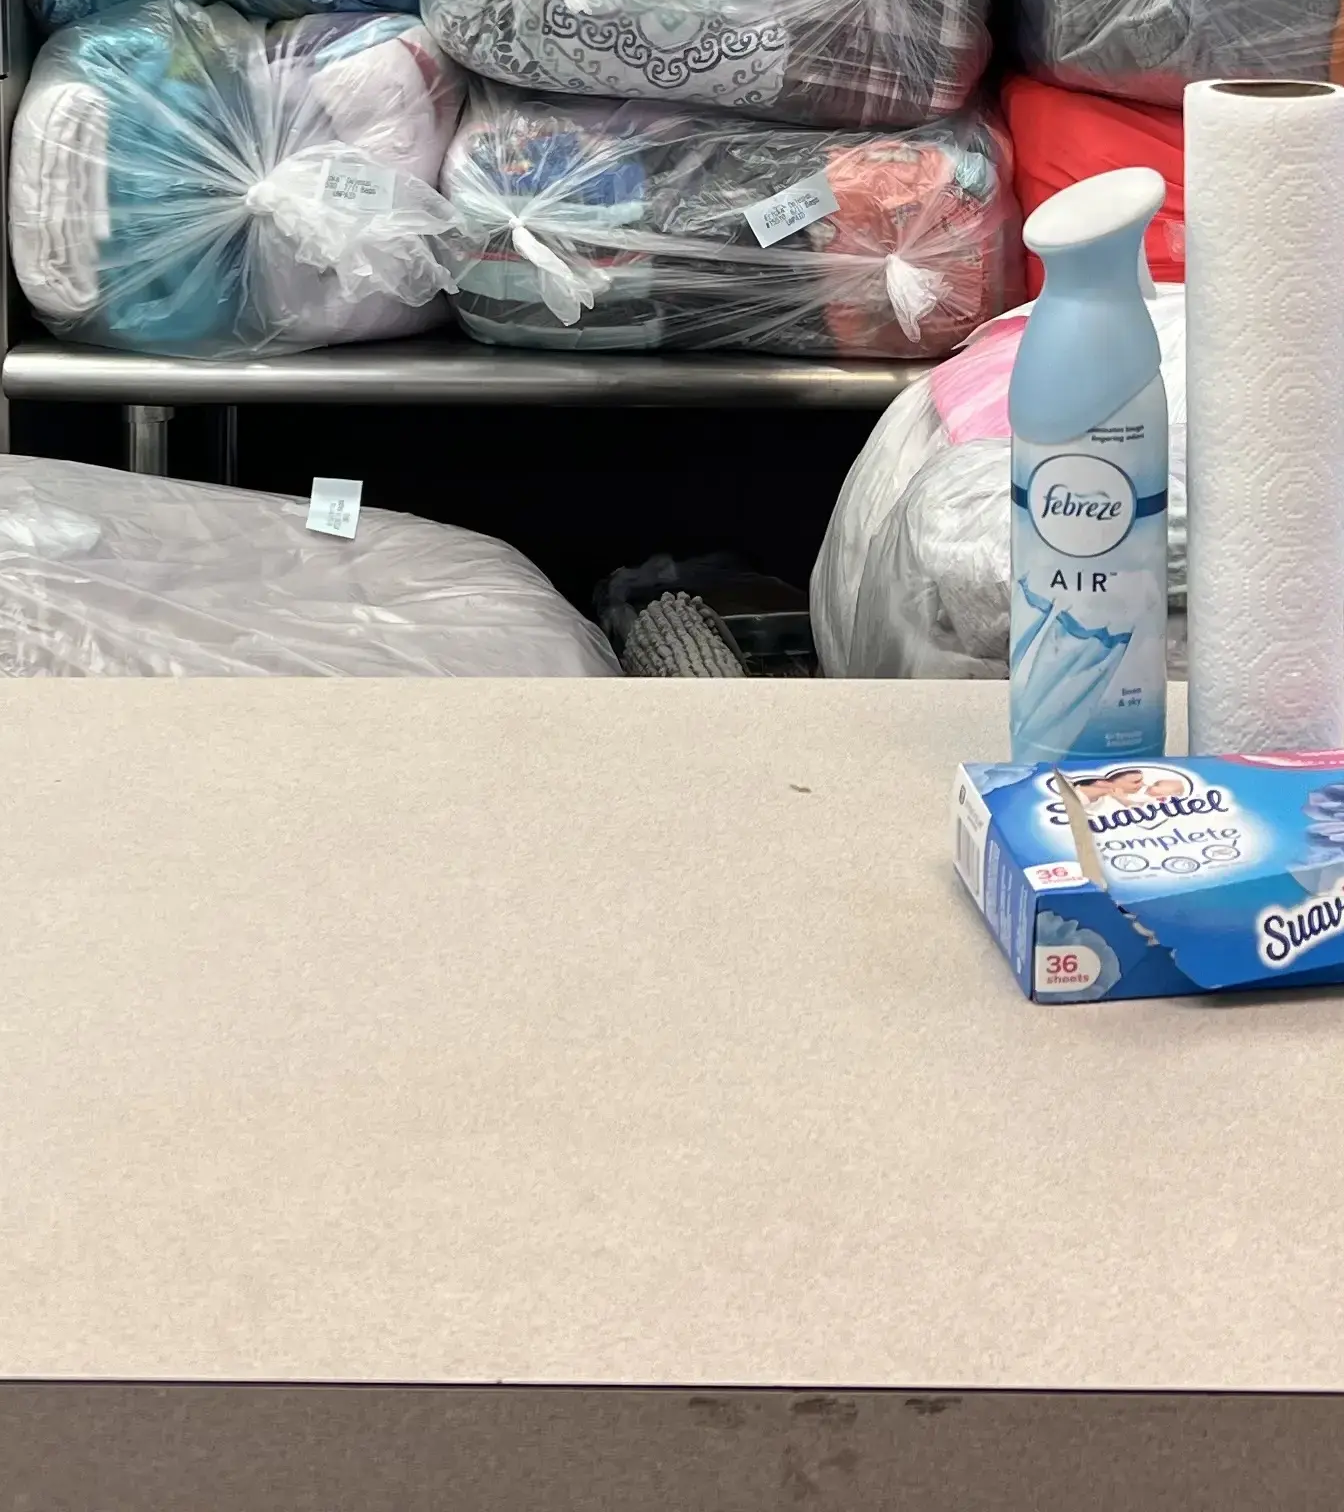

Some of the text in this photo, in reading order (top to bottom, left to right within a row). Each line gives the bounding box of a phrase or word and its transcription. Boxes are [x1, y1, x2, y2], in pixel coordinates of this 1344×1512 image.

[1040, 484, 1123, 521] febreze
[1046, 789, 1229, 833] Suavitel
[1036, 866, 1068, 880] 36
[1045, 954, 1078, 974] 36
[1046, 974, 1090, 985] sheets
